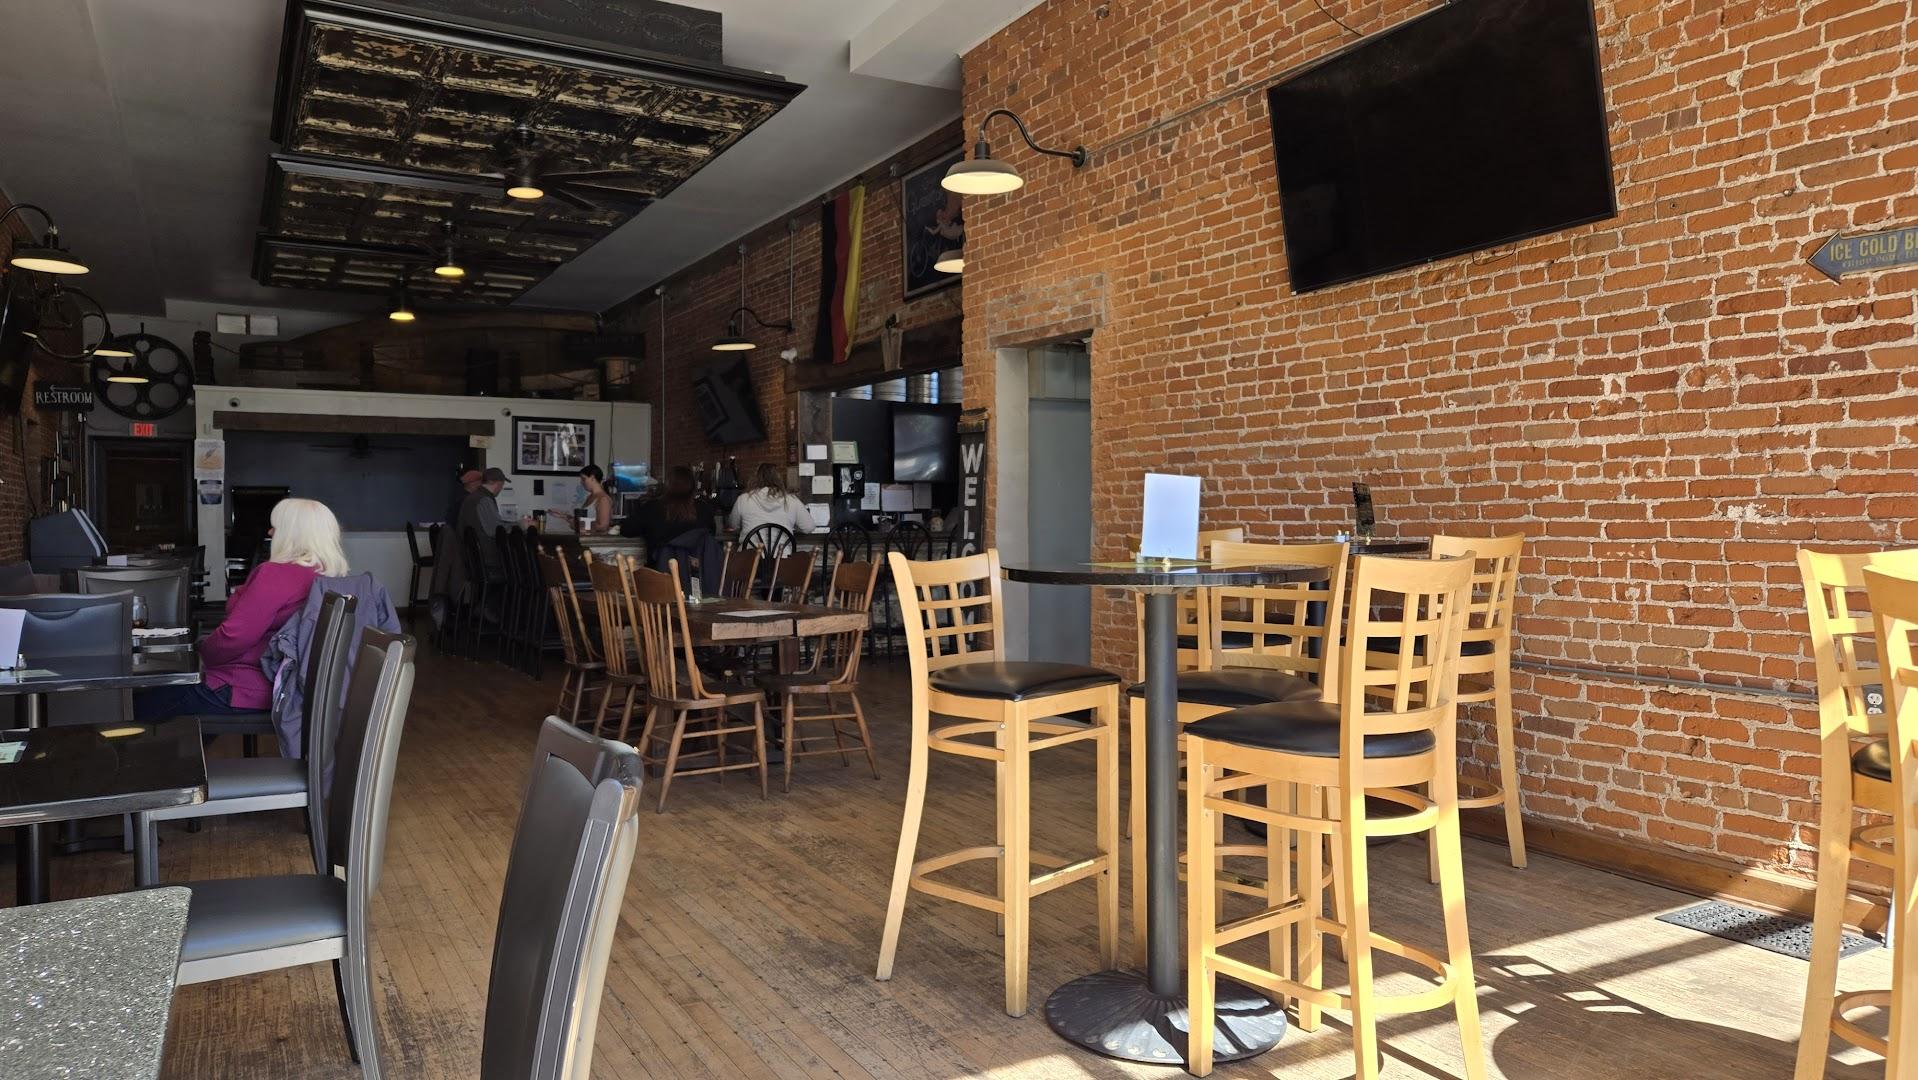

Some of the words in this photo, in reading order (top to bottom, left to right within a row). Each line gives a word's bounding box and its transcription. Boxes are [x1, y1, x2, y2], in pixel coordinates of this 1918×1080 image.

[1830, 243, 1852, 261] ICE
[1860, 236, 1897, 257] COLD
[36, 391, 92, 404] RESTROOM
[133, 423, 153, 437] EXIT
